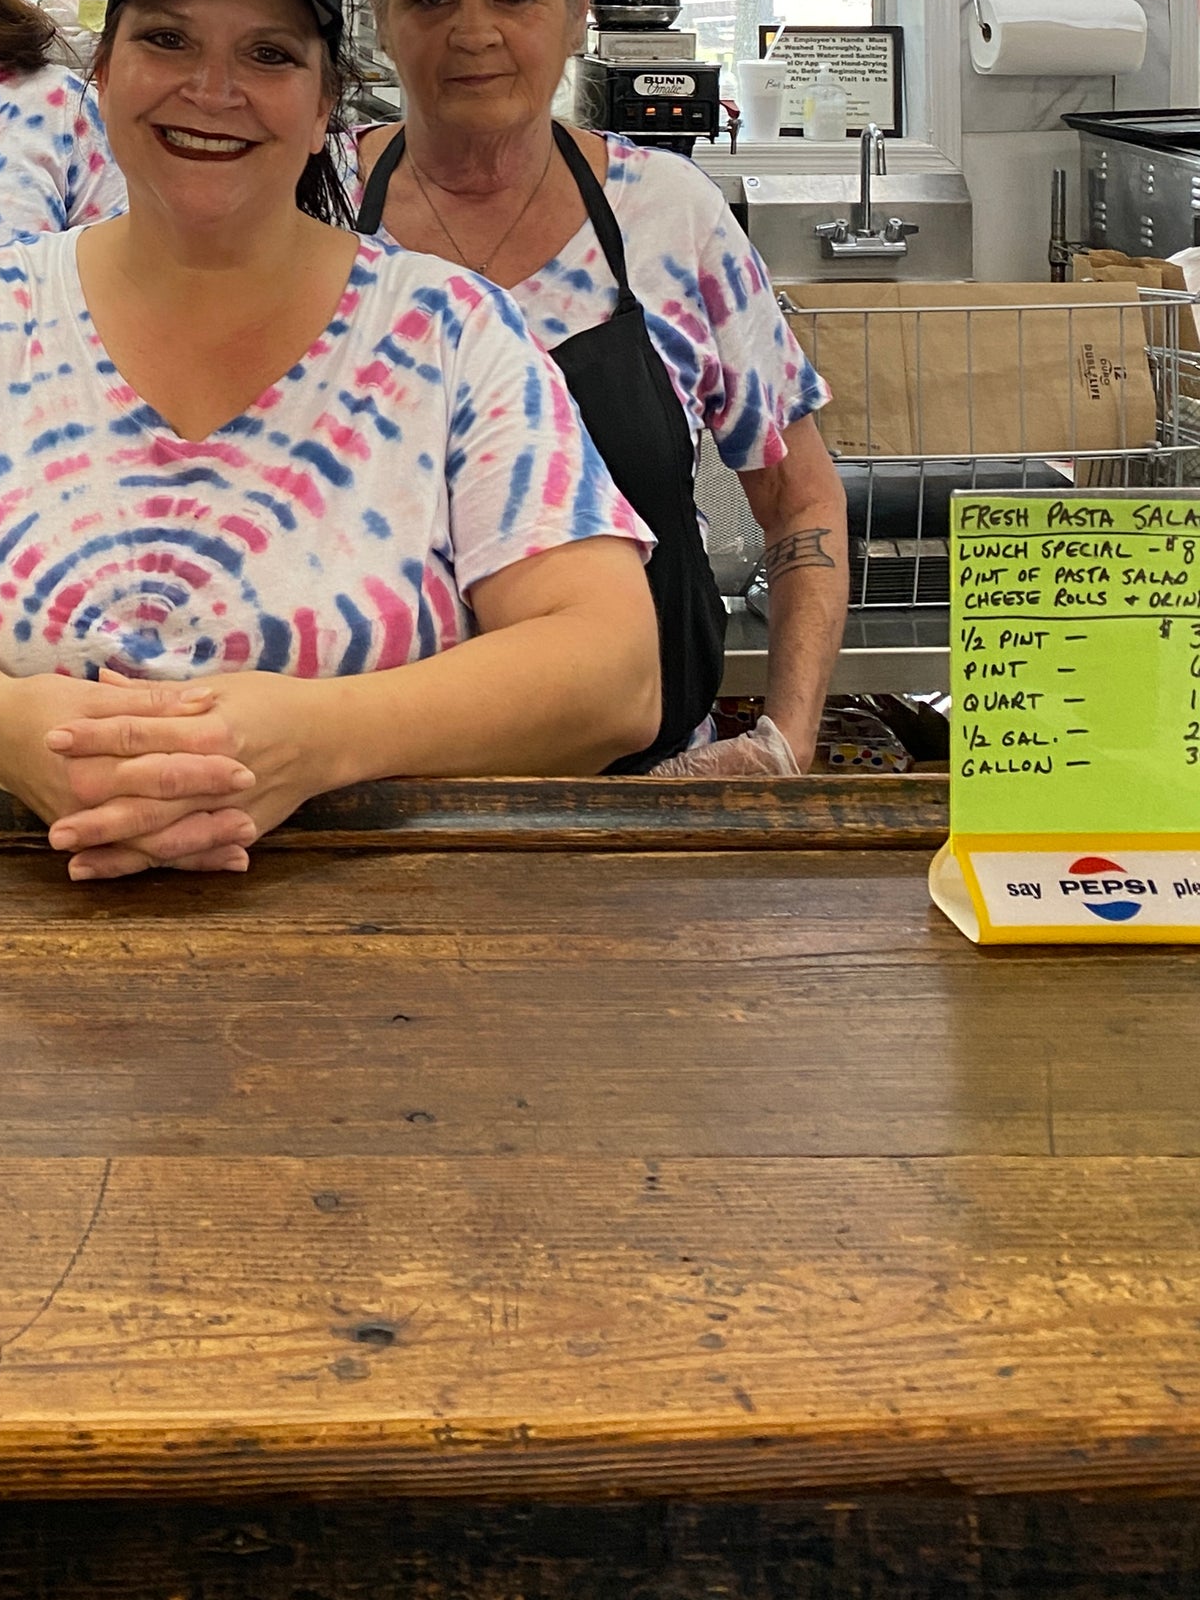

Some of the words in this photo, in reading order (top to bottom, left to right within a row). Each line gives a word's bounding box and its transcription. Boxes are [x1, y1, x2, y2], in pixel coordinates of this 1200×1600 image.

[866, 44, 888, 52] Using
[644, 76, 686, 84] BUNN
[960, 504, 1030, 530] FRESH
[1047, 501, 1114, 528] PASTA
[958, 541, 1029, 561] LUNCH
[1041, 539, 1134, 559] SPECIAL
[960, 566, 1009, 587] PINT
[1018, 567, 1040, 583] OF
[1054, 567, 1110, 585] PASTA
[1122, 568, 1188, 586] SALAD
[965, 590, 1042, 609] CHEESE
[1053, 588, 1107, 608] ROLLS
[999, 631, 1050, 650] PINT
[963, 660, 1028, 681] PINT
[963, 691, 1045, 712] QUART
[1001, 730, 1058, 748] GAL.
[961, 755, 1053, 778] GALLON
[1006, 881, 1042, 900] say
[1059, 879, 1158, 896] PEPSI
